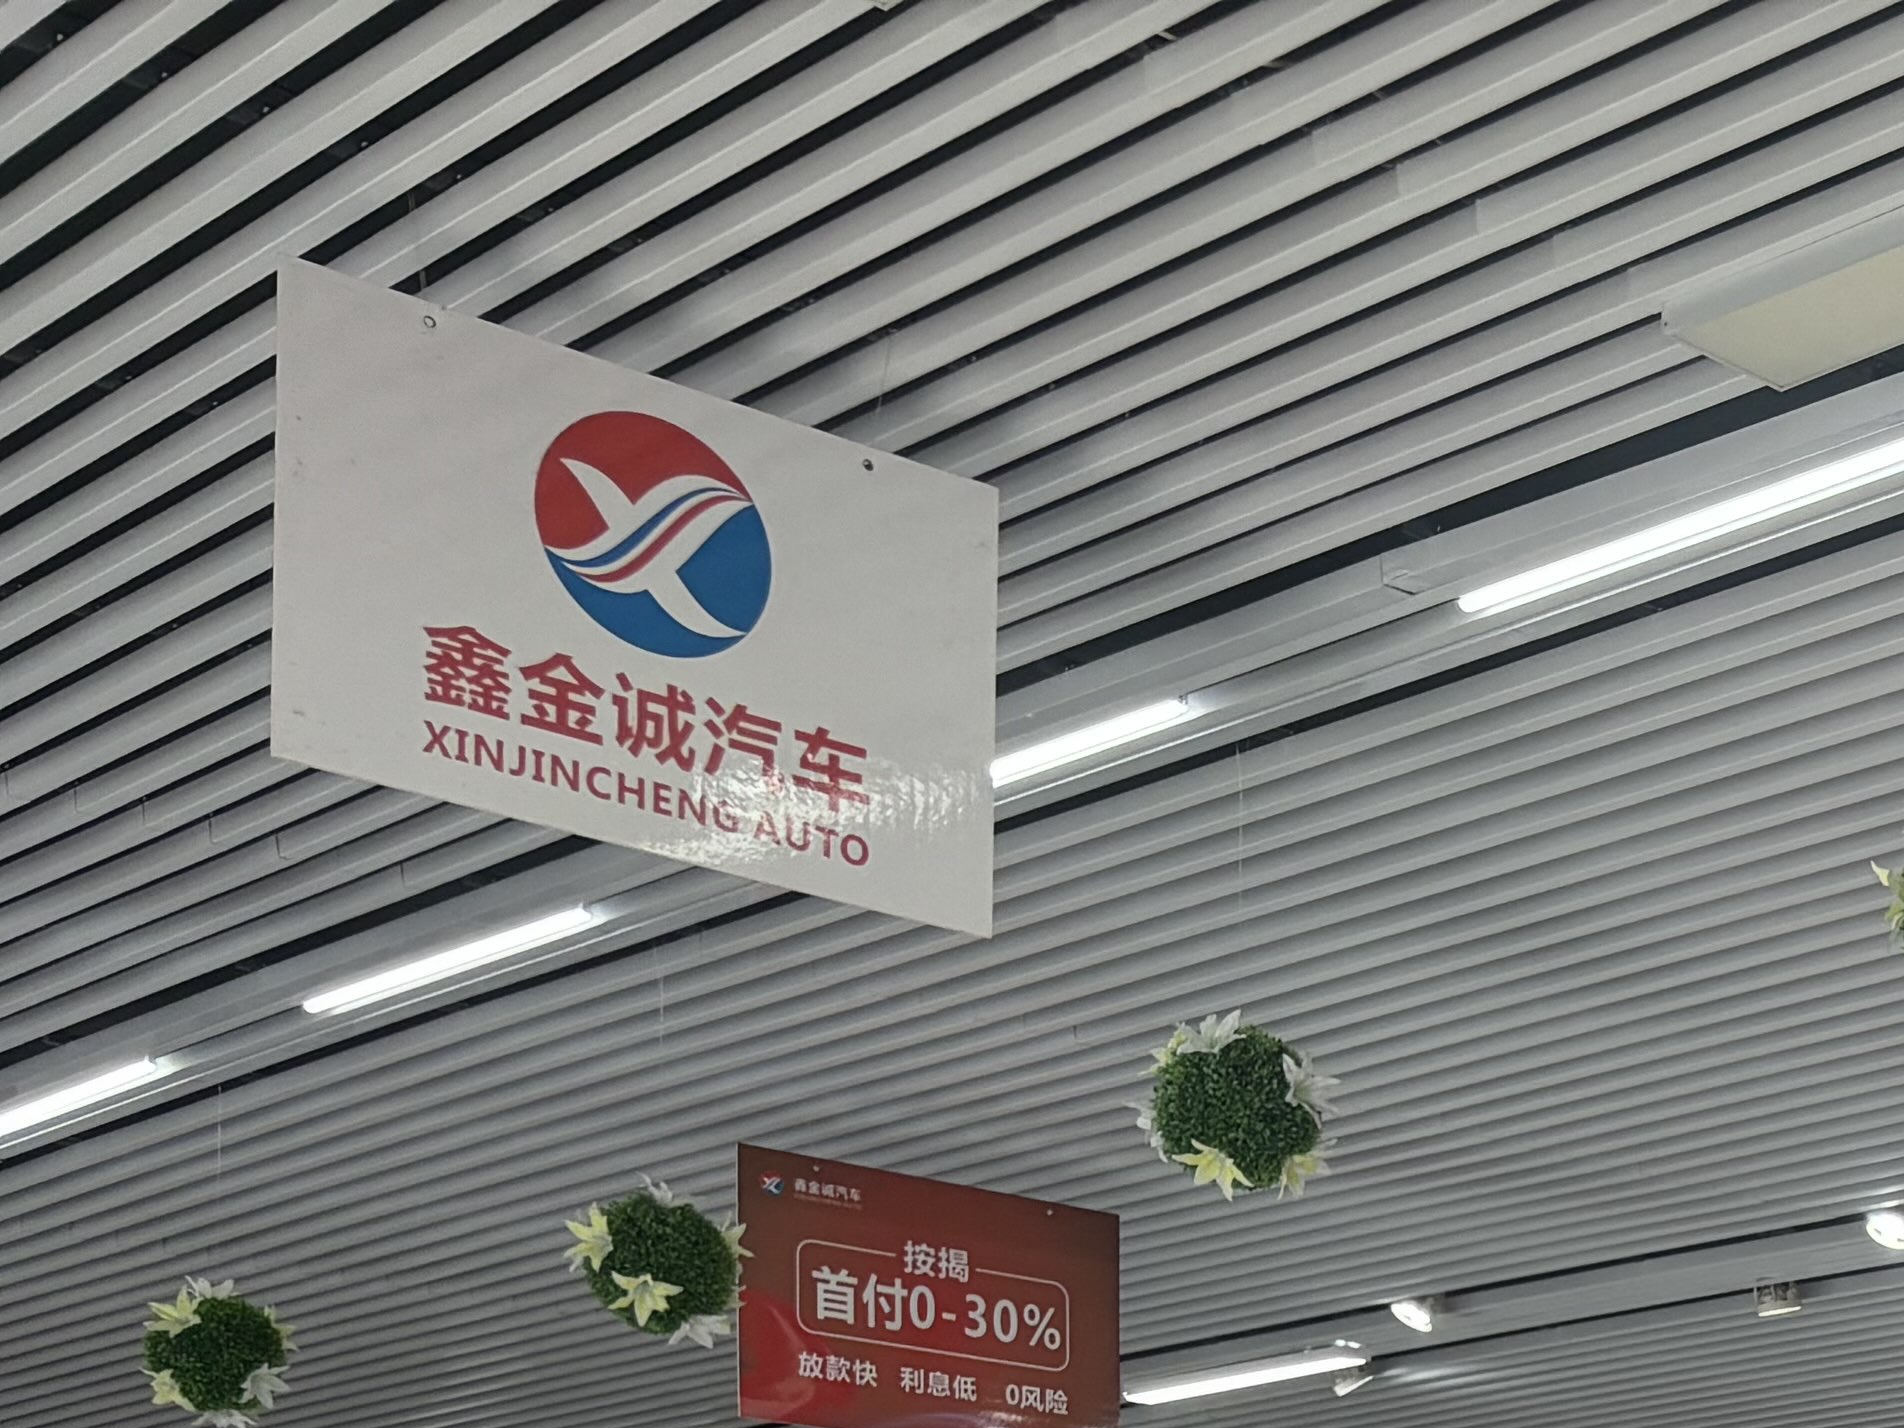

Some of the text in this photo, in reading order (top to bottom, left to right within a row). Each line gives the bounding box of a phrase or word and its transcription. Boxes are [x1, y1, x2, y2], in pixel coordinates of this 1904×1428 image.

[423, 624, 872, 814] 鑫金诚汽车
[423, 720, 869, 867] XINJINCHENG AUTO
[904, 1240, 970, 1283] 按揭
[811, 1265, 1062, 1350] 首付0-30%
[798, 1352, 1068, 1415] 放款快 利息低 0风险
